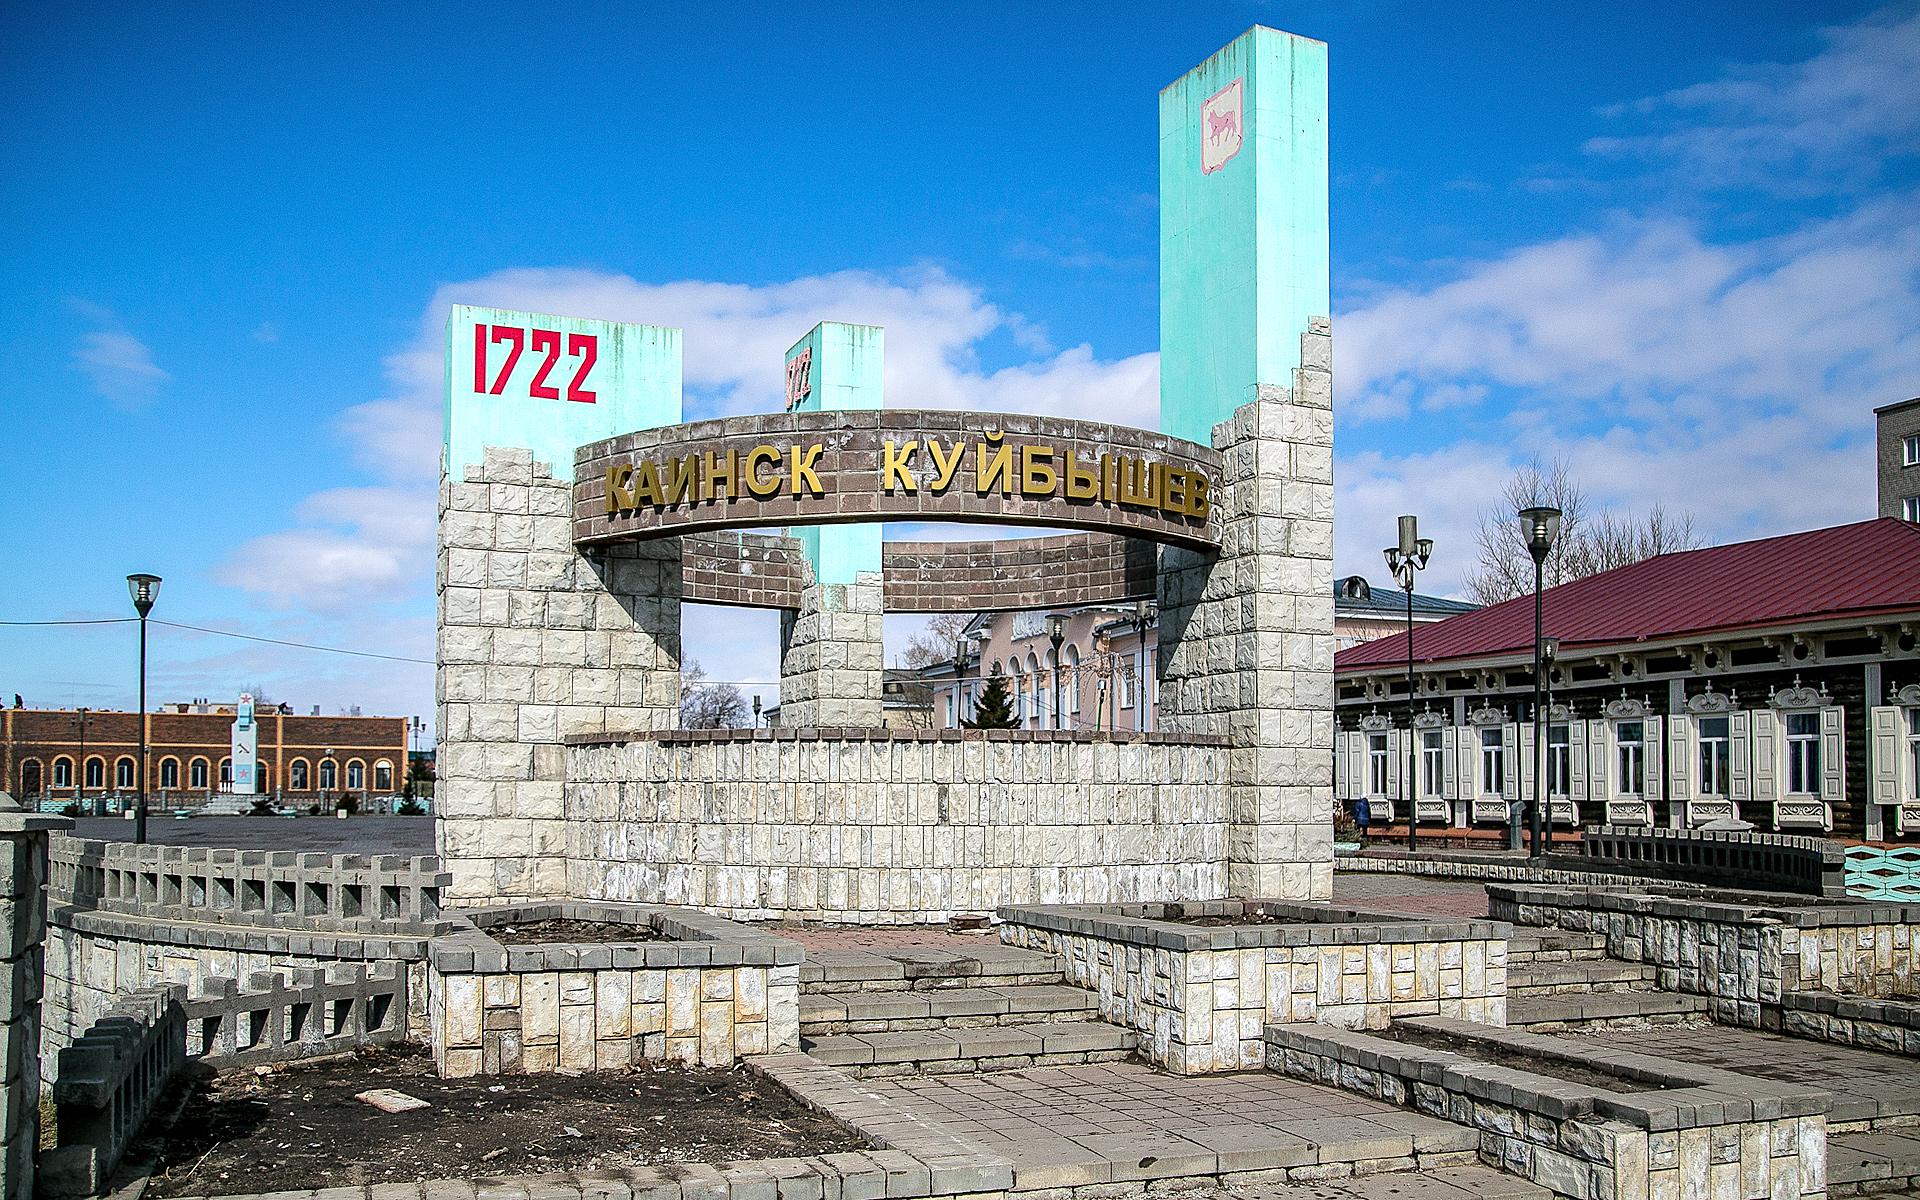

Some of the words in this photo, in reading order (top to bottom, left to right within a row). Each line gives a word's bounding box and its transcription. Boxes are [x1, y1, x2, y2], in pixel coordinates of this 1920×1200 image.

[474, 323, 597, 404] 1722
[785, 346, 812, 409] 1722
[605, 443, 825, 513] КАИНСК
[883, 430, 1209, 519] КУЙБЫШЕВ
